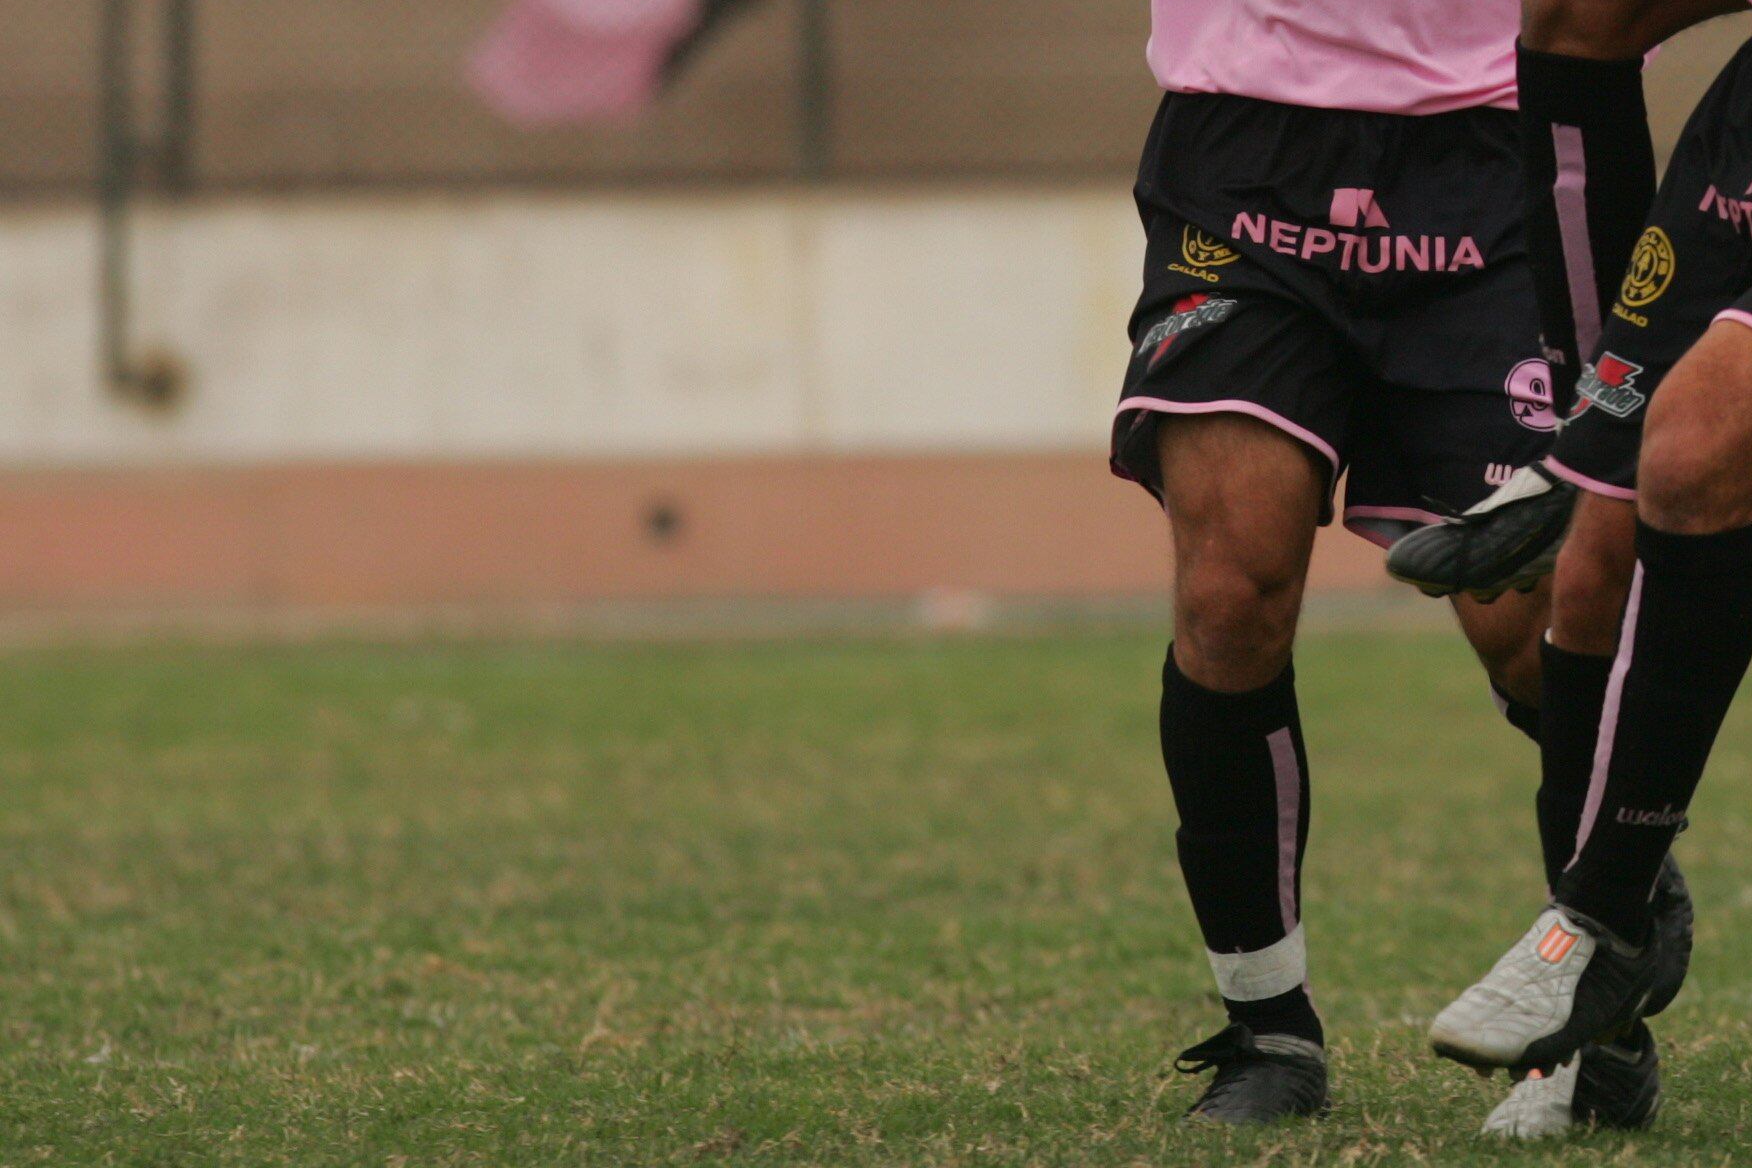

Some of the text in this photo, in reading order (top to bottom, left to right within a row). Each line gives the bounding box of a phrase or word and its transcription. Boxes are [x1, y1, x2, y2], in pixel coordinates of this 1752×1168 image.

[1231, 211, 1486, 274] NEPTUNIA
[1167, 262, 1220, 283] CALLAO
[1616, 803, 1685, 826] walo
